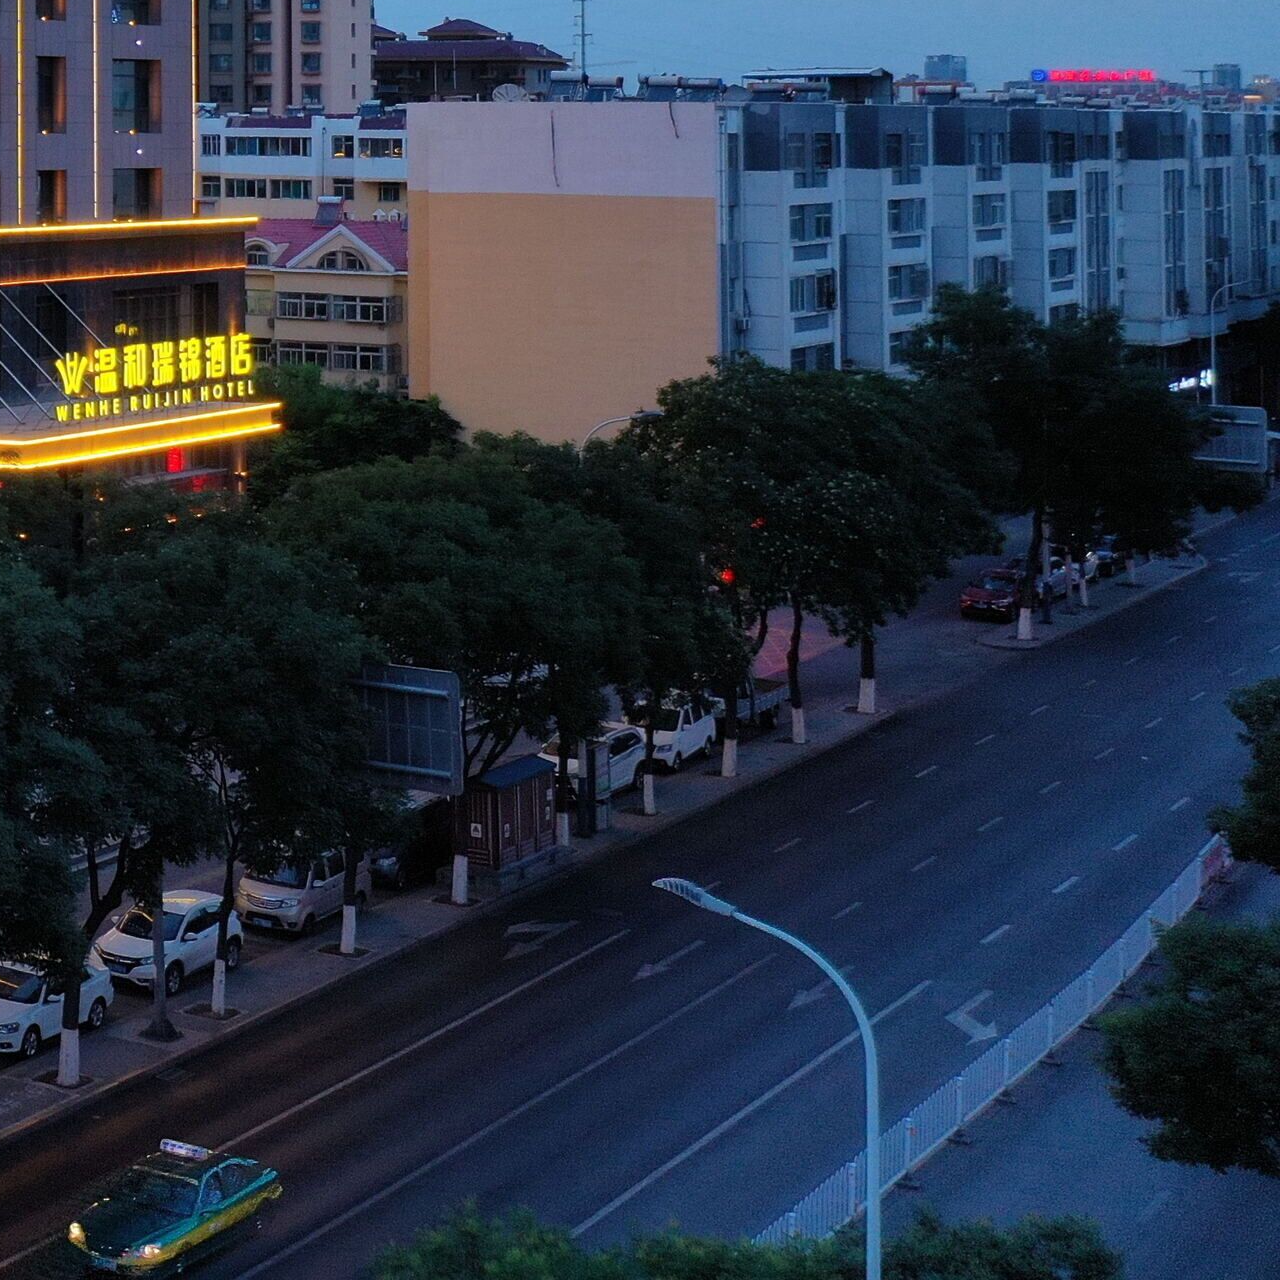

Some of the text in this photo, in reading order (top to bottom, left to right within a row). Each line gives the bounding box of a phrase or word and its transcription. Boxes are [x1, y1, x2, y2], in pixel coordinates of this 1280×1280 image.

[93, 333, 252, 394] 温和瑞锦酒店
[56, 380, 255, 422] WENHE RUIJIN HOTEL
